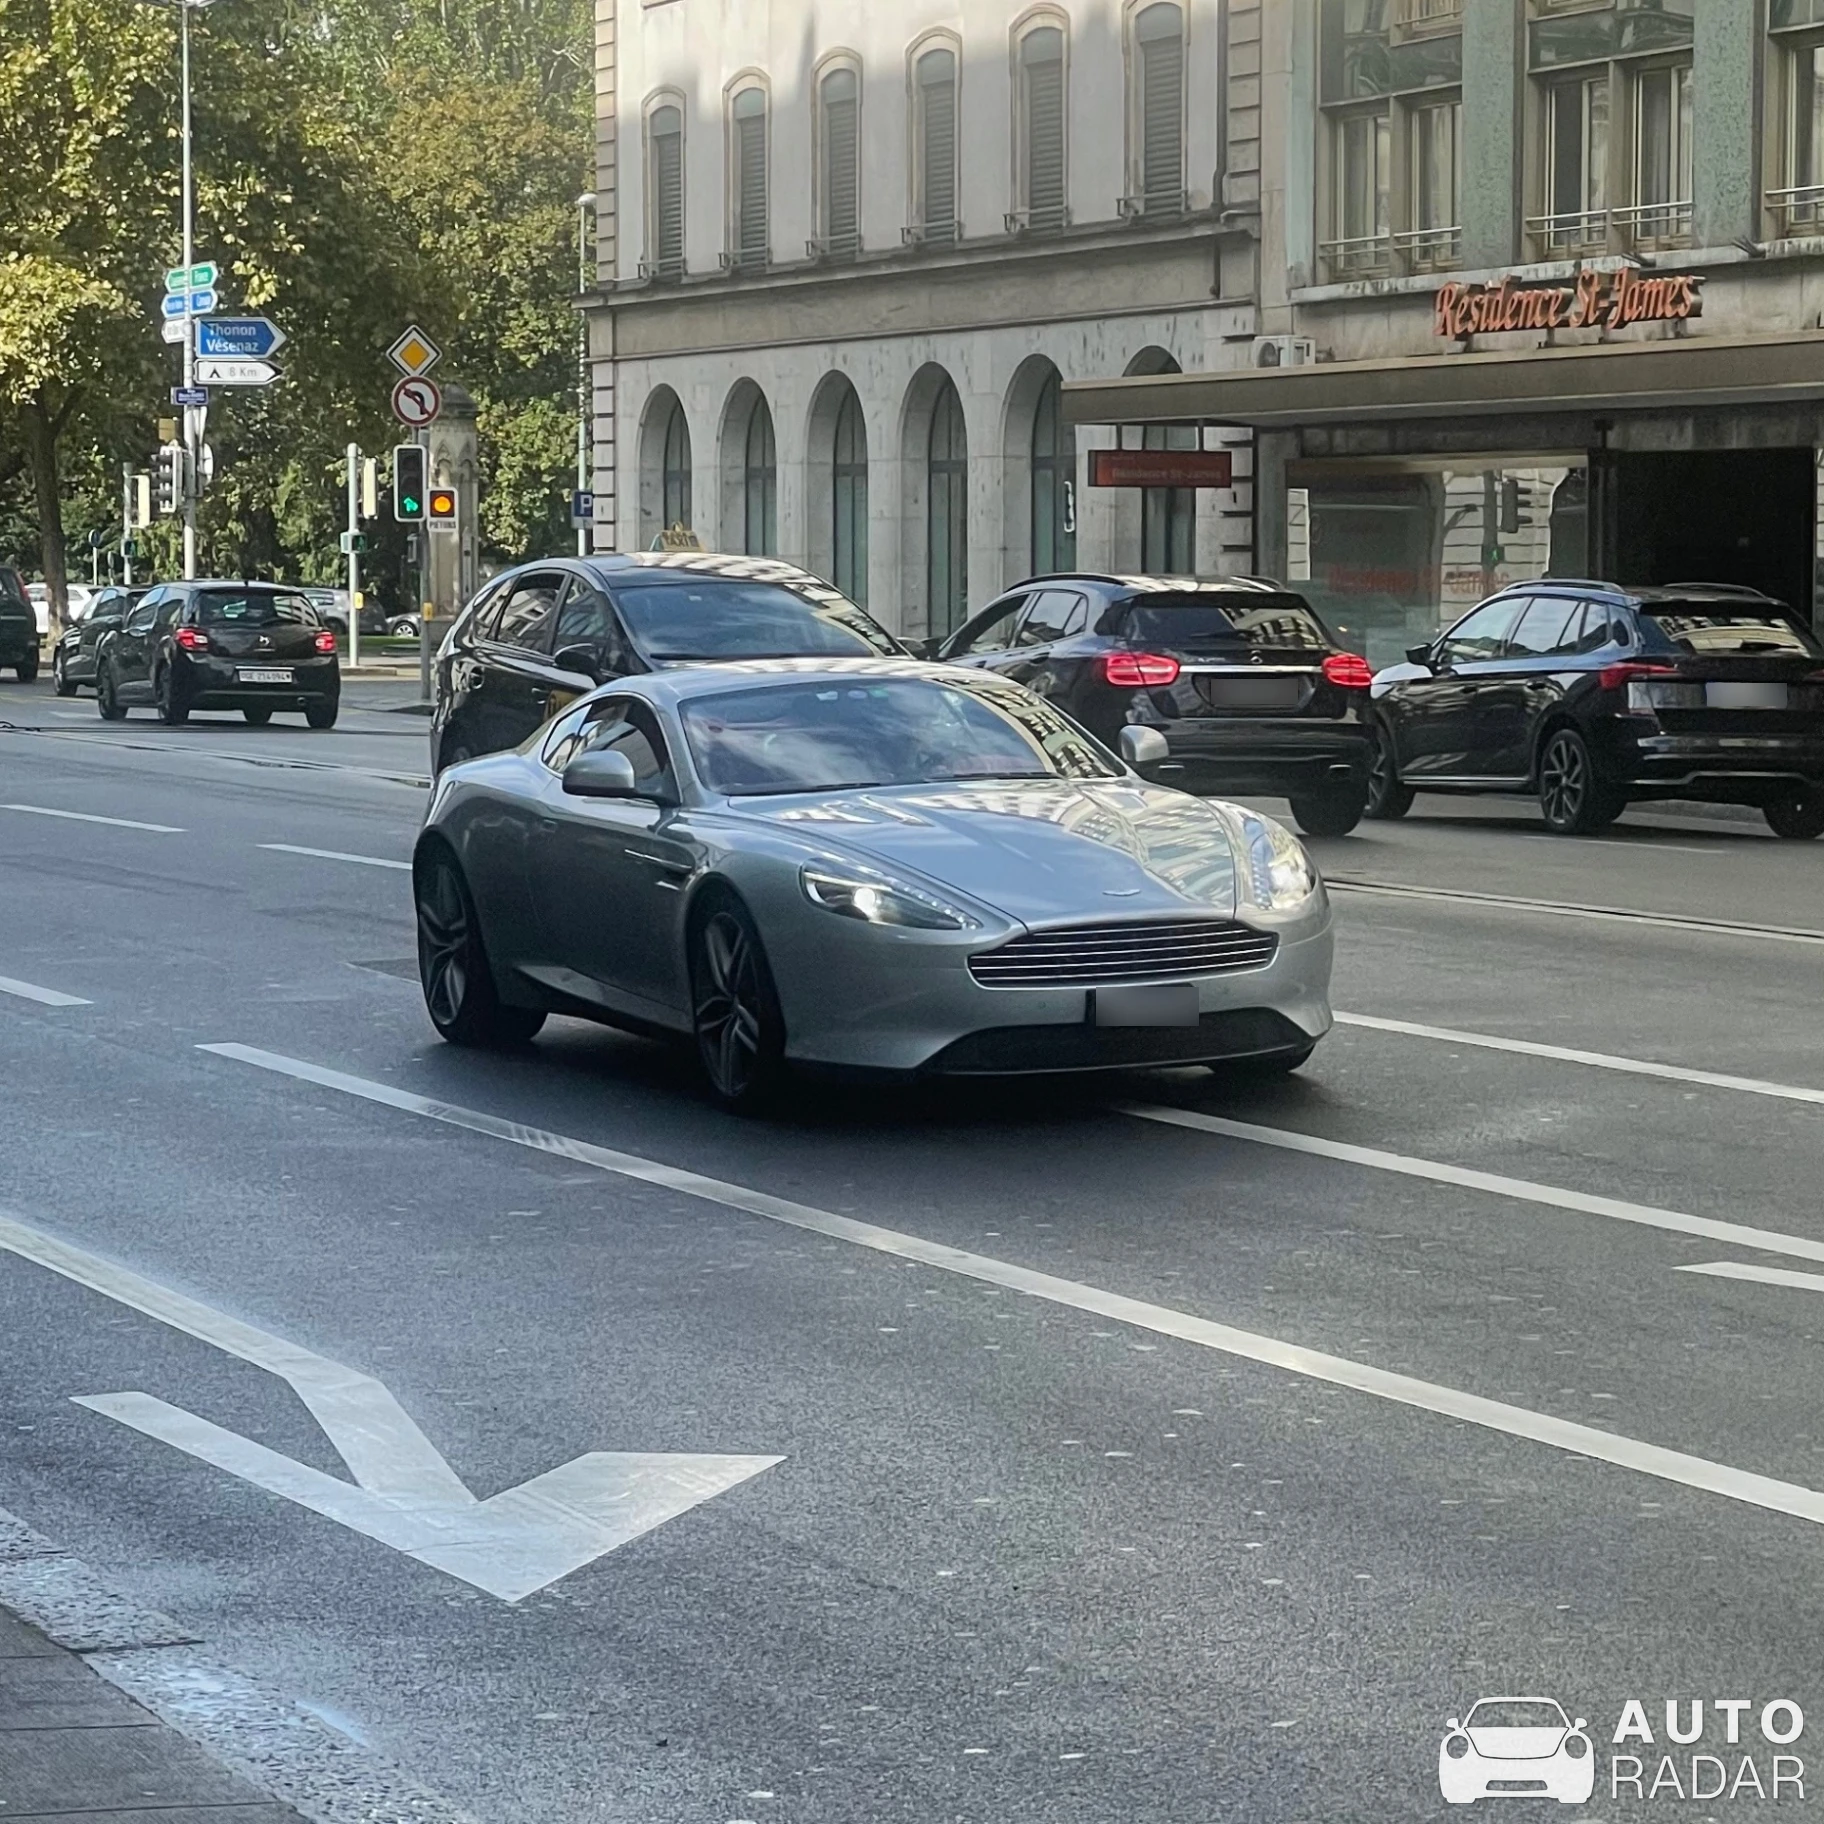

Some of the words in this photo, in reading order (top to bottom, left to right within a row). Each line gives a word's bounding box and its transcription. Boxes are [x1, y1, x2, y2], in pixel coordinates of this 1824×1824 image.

[1434, 273, 1564, 341] Résidence
[1568, 266, 1693, 330] St-James
[209, 323, 256, 336] Thonon
[206, 338, 259, 352] Vésenaz
[229, 368, 236, 377] 8
[240, 368, 257, 377] Km
[580, 494, 593, 515] P
